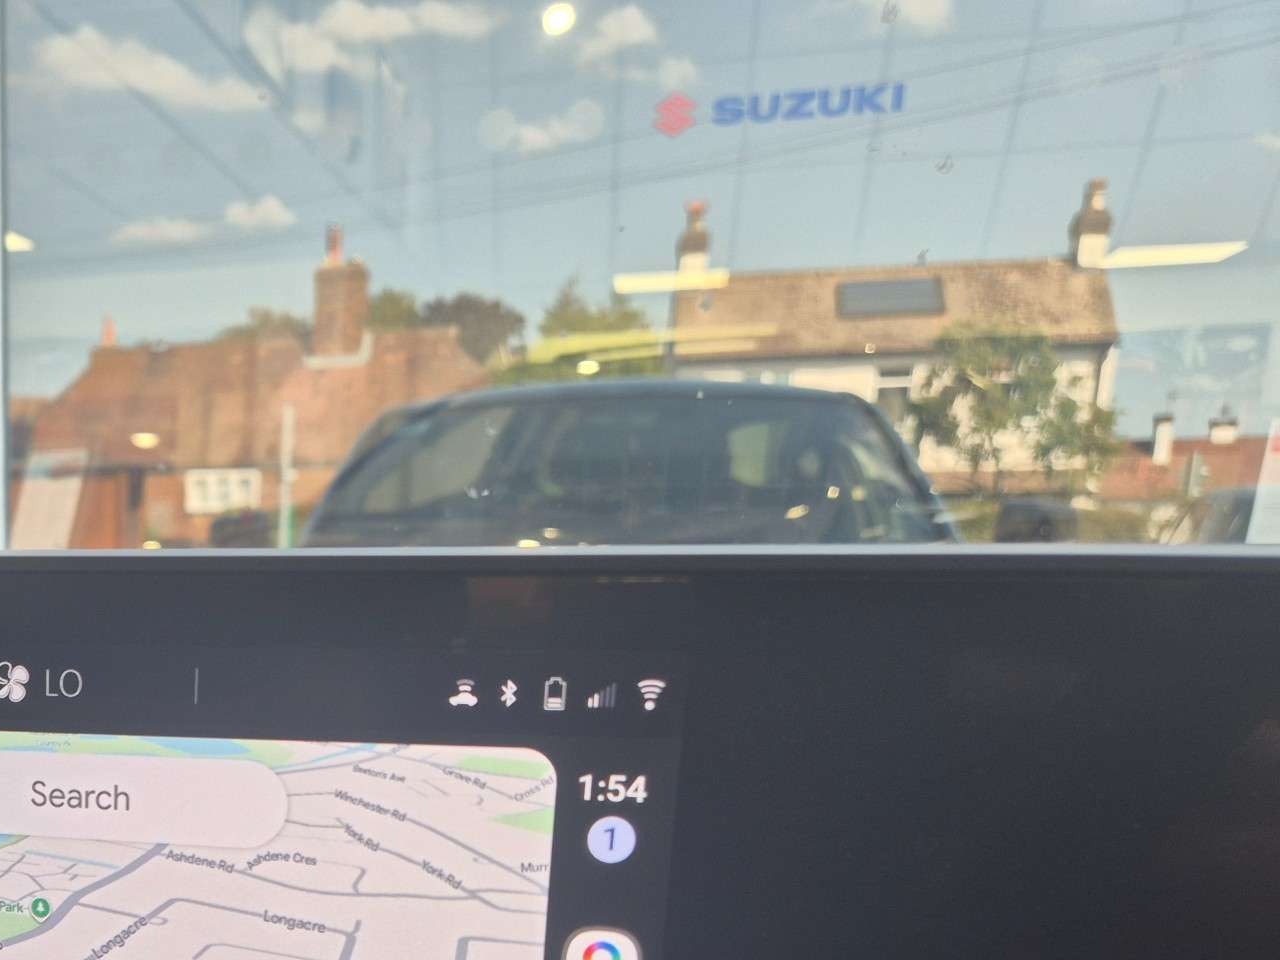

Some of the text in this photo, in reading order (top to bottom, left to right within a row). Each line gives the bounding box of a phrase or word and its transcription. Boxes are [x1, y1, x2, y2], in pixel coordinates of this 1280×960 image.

[712, 81, 906, 126] SUZUKI
[44, 670, 84, 699] LO
[30, 780, 131, 812] Search
[579, 774, 648, 803] 1:54
[334, 789, 407, 822] Winchester Rd
[344, 824, 380, 852] York Rd
[166, 849, 234, 874] Ashdene Rd
[246, 851, 318, 871] Ashdene Cres
[420, 860, 463, 890] York Rd
[263, 909, 326, 934] Longacre
[91, 917, 148, 960] Longacre
